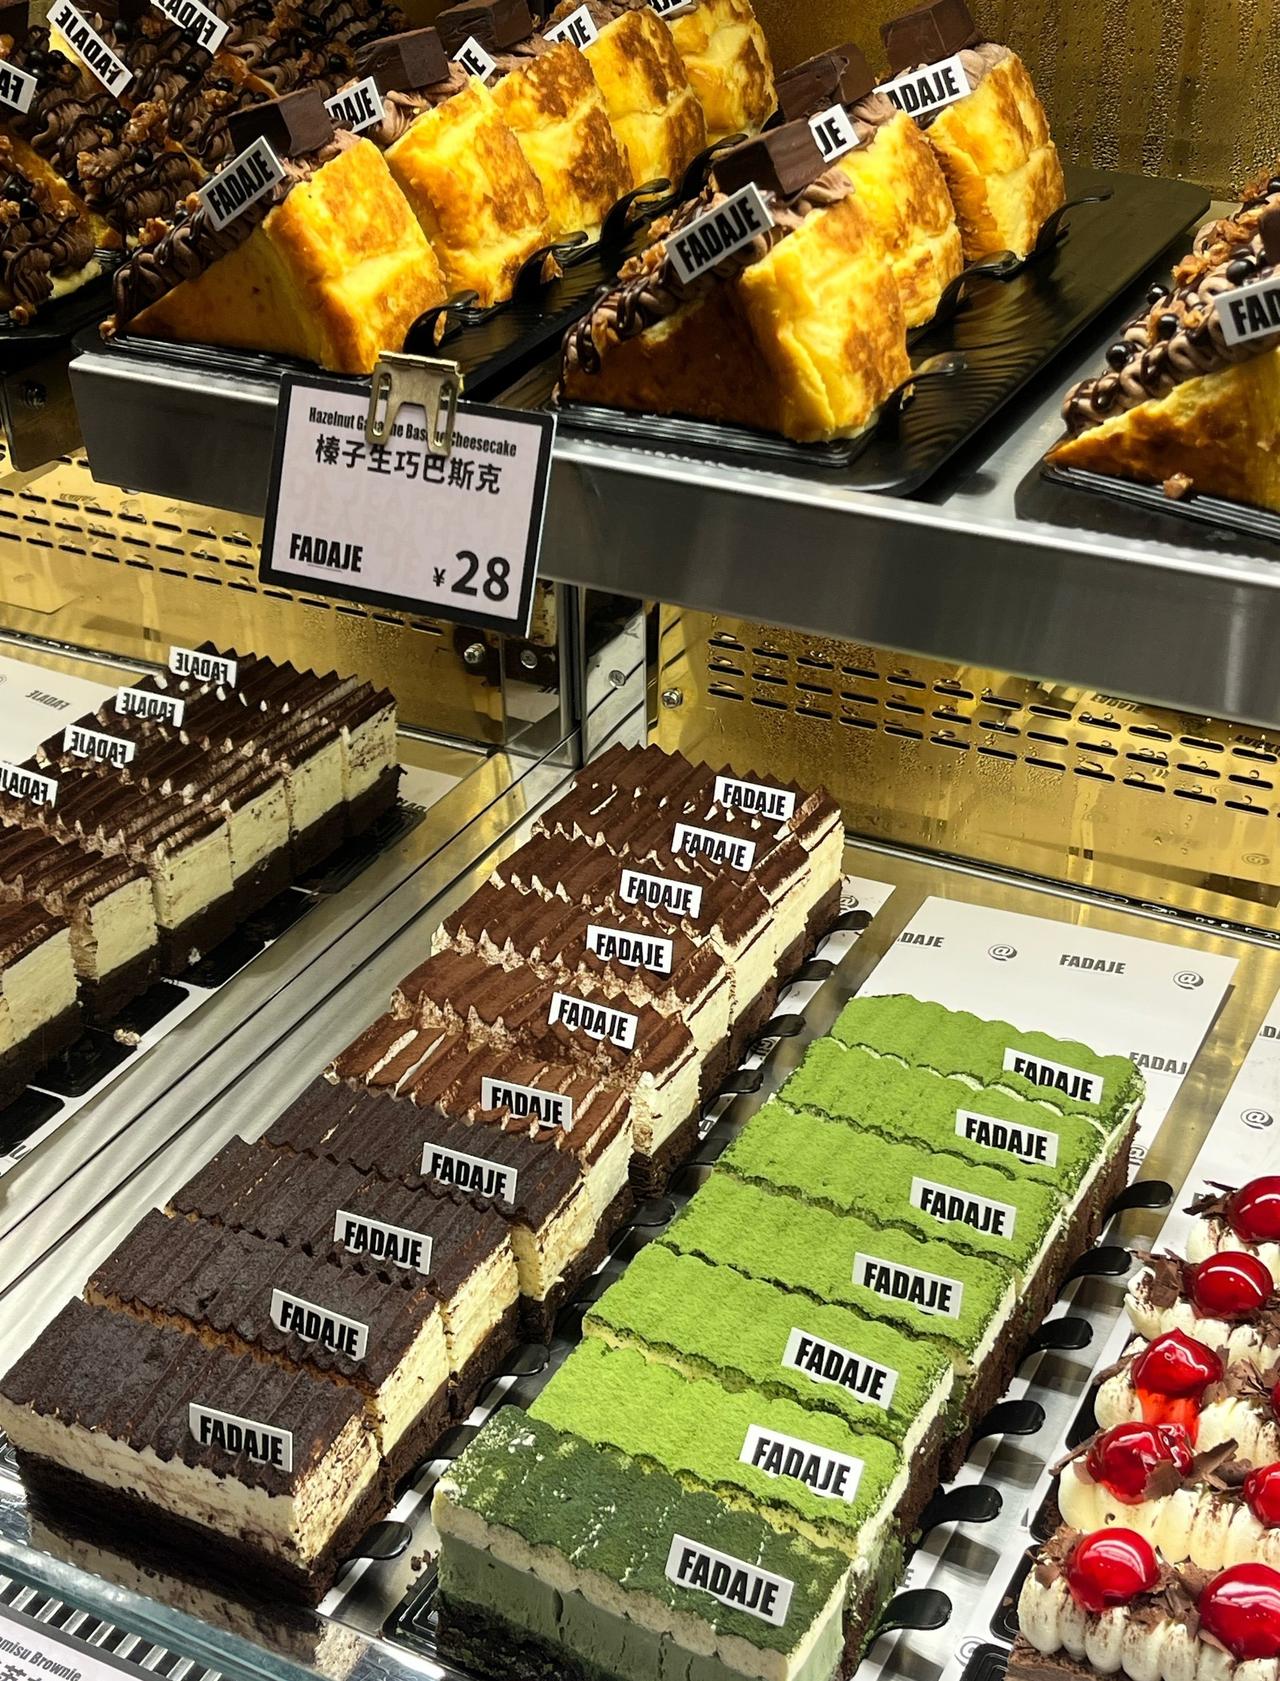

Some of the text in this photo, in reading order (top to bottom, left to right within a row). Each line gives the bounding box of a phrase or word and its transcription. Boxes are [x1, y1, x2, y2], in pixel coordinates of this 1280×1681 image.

[327, 87, 376, 125] DAJE
[886, 66, 960, 113] ADAJE
[207, 150, 274, 222] FADAJE
[675, 196, 761, 274] FADAJE
[1229, 288, 1280, 336] FAD
[309, 407, 354, 430] Hazelnut
[315, 434, 502, 495] 榛子生巧巴斯克
[289, 533, 363, 573] FADAJE
[723, 783, 787, 816] FADAJE
[681, 831, 747, 867] FADAJE
[627, 876, 693, 911] FADAJE
[596, 933, 665, 968] FADAJE
[898, 932, 944, 948] DAJE
[1059, 954, 1126, 975] FADAJE
[558, 999, 628, 1041] FADAJE
[1013, 1057, 1093, 1101] FADAJE
[1129, 1052, 1189, 1075] FADAJ
[491, 1086, 563, 1124] FADAJE
[965, 1117, 1047, 1161] FADAJE
[430, 1152, 507, 1197] FADAJE
[920, 1187, 1006, 1237] FADAJE
[344, 1220, 422, 1268] FADAJE
[863, 1262, 953, 1312] FADAJE
[280, 1300, 359, 1356] FADAJE
[794, 1336, 887, 1401] FADAJE
[200, 1415, 283, 1466] FADAJE
[752, 1437, 851, 1497] FADAJE
[677, 1547, 779, 1617] FADAJE
[29, 1651, 82, 1681] Brownie
